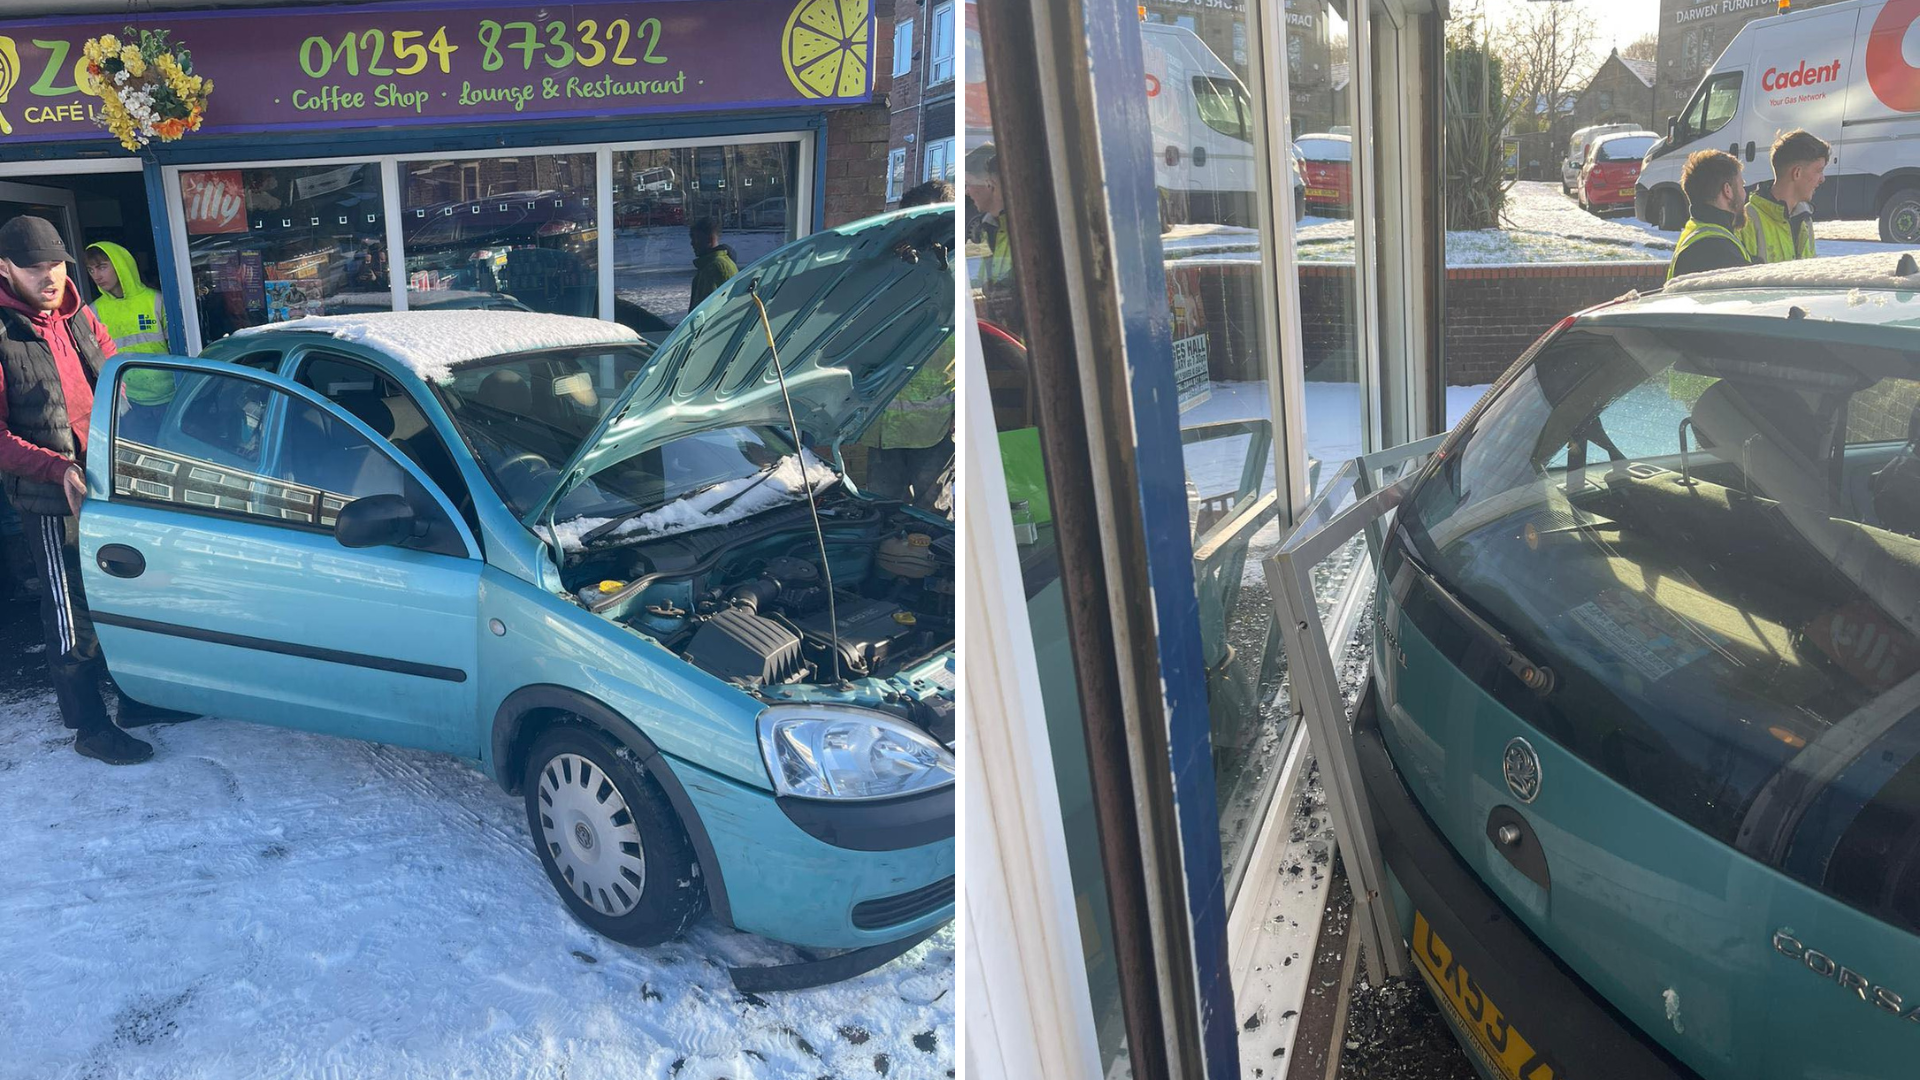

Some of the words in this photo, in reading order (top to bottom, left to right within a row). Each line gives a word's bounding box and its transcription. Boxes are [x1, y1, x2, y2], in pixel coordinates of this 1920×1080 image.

[1676, 3, 1718, 24] DARWEN
[1722, 0, 1776, 13] FURNI
[299, 26, 459, 79] 01254
[479, 17, 668, 72] 873322
[1762, 59, 1841, 92] Cadent
[292, 84, 367, 110] Coffee
[374, 84, 429, 113] Shop
[458, 80, 534, 111] Lounge
[542, 78, 560, 99] &
[567, 71, 687, 98] Restaurant
[1769, 98, 1783, 107] Your
[1784, 96, 1797, 104] Gas
[1798, 92, 1826, 102] Network
[24, 100, 85, 123] CAFÉ
[190, 180, 242, 228] illy
[1187, 337, 1205, 356] HALL
